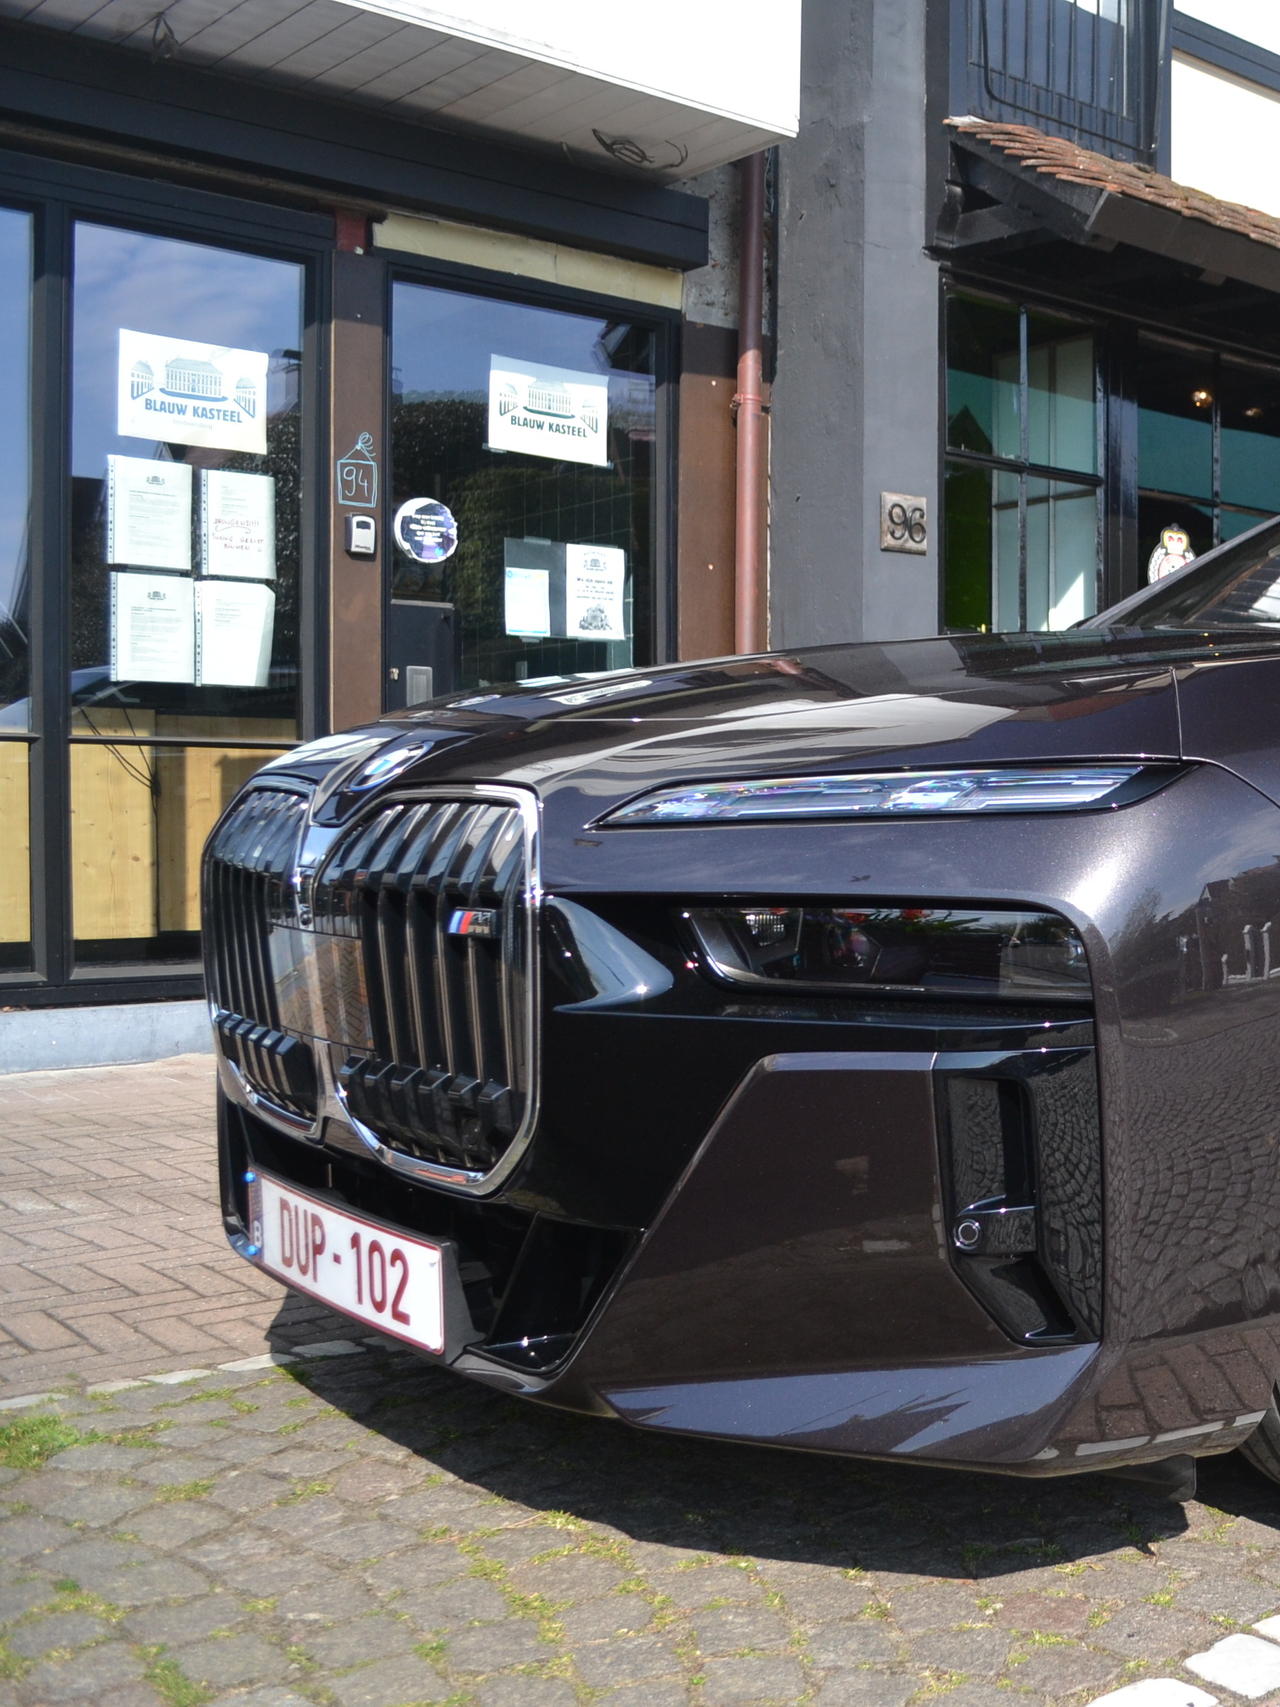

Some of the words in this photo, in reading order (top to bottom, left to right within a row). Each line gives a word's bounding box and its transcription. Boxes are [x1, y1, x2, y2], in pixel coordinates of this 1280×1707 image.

[144, 397, 188, 416] BLAUW
[192, 405, 243, 424] KASTEEL
[510, 414, 545, 431] BLAUW
[548, 421, 588, 438] KASTEEL
[343, 466, 369, 497] 94
[887, 502, 927, 544] 96
[253, 1219, 263, 1249] B
